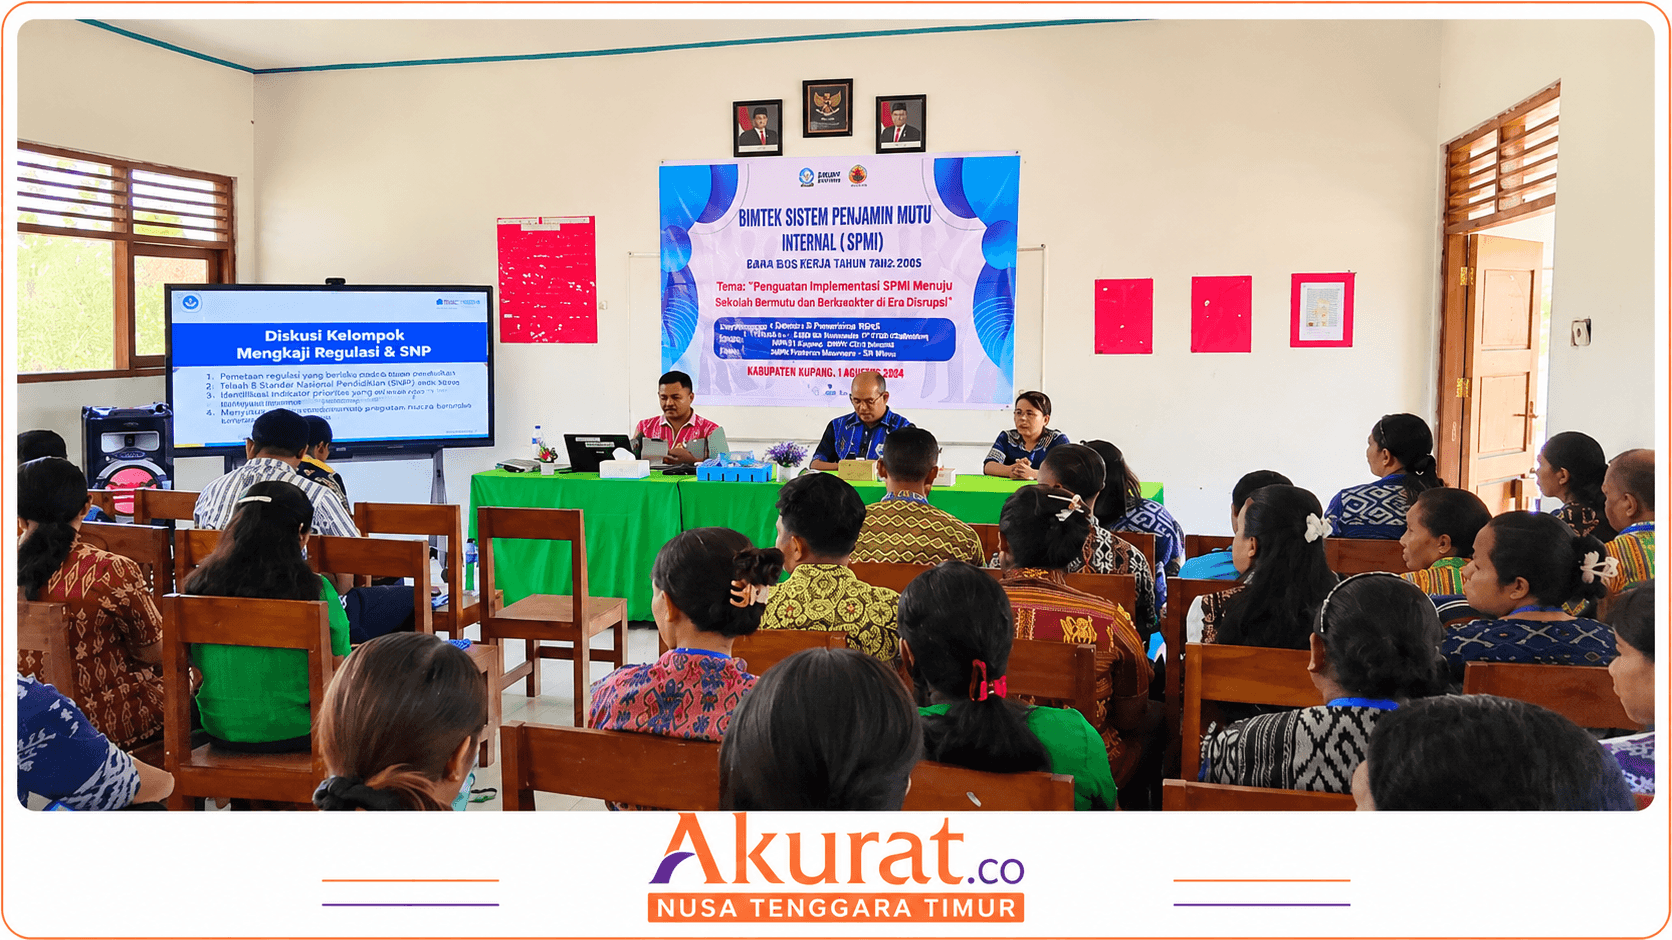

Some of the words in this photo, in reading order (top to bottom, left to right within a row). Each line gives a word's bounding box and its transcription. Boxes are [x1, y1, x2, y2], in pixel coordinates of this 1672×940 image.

[739, 208, 782, 227] BIMTEK
[785, 207, 829, 226] SISTEM
[832, 206, 893, 226] PENJAMIN
[897, 205, 932, 224] MUTU
[782, 233, 836, 251] INTERNAL
[776, 259, 798, 269] BOS
[800, 258, 831, 269] KERJA
[834, 258, 866, 268] TAHUN
[716, 281, 746, 291] Tema:
[810, 280, 880, 293] Implementasi
[883, 280, 910, 291] SPMI
[913, 280, 953, 293] Menuju
[715, 297, 753, 307] Sekolah
[755, 297, 796, 307] Bermutu
[797, 297, 816, 307] dan
[876, 297, 886, 307] di
[265, 329, 322, 341] Diskusi
[327, 329, 405, 343] Kelompok
[236, 347, 310, 362] Mengkaji
[315, 346, 380, 361] Regulasi
[384, 347, 396, 357] &
[400, 346, 432, 357] SNP
[747, 366, 796, 376] KABUPATEN
